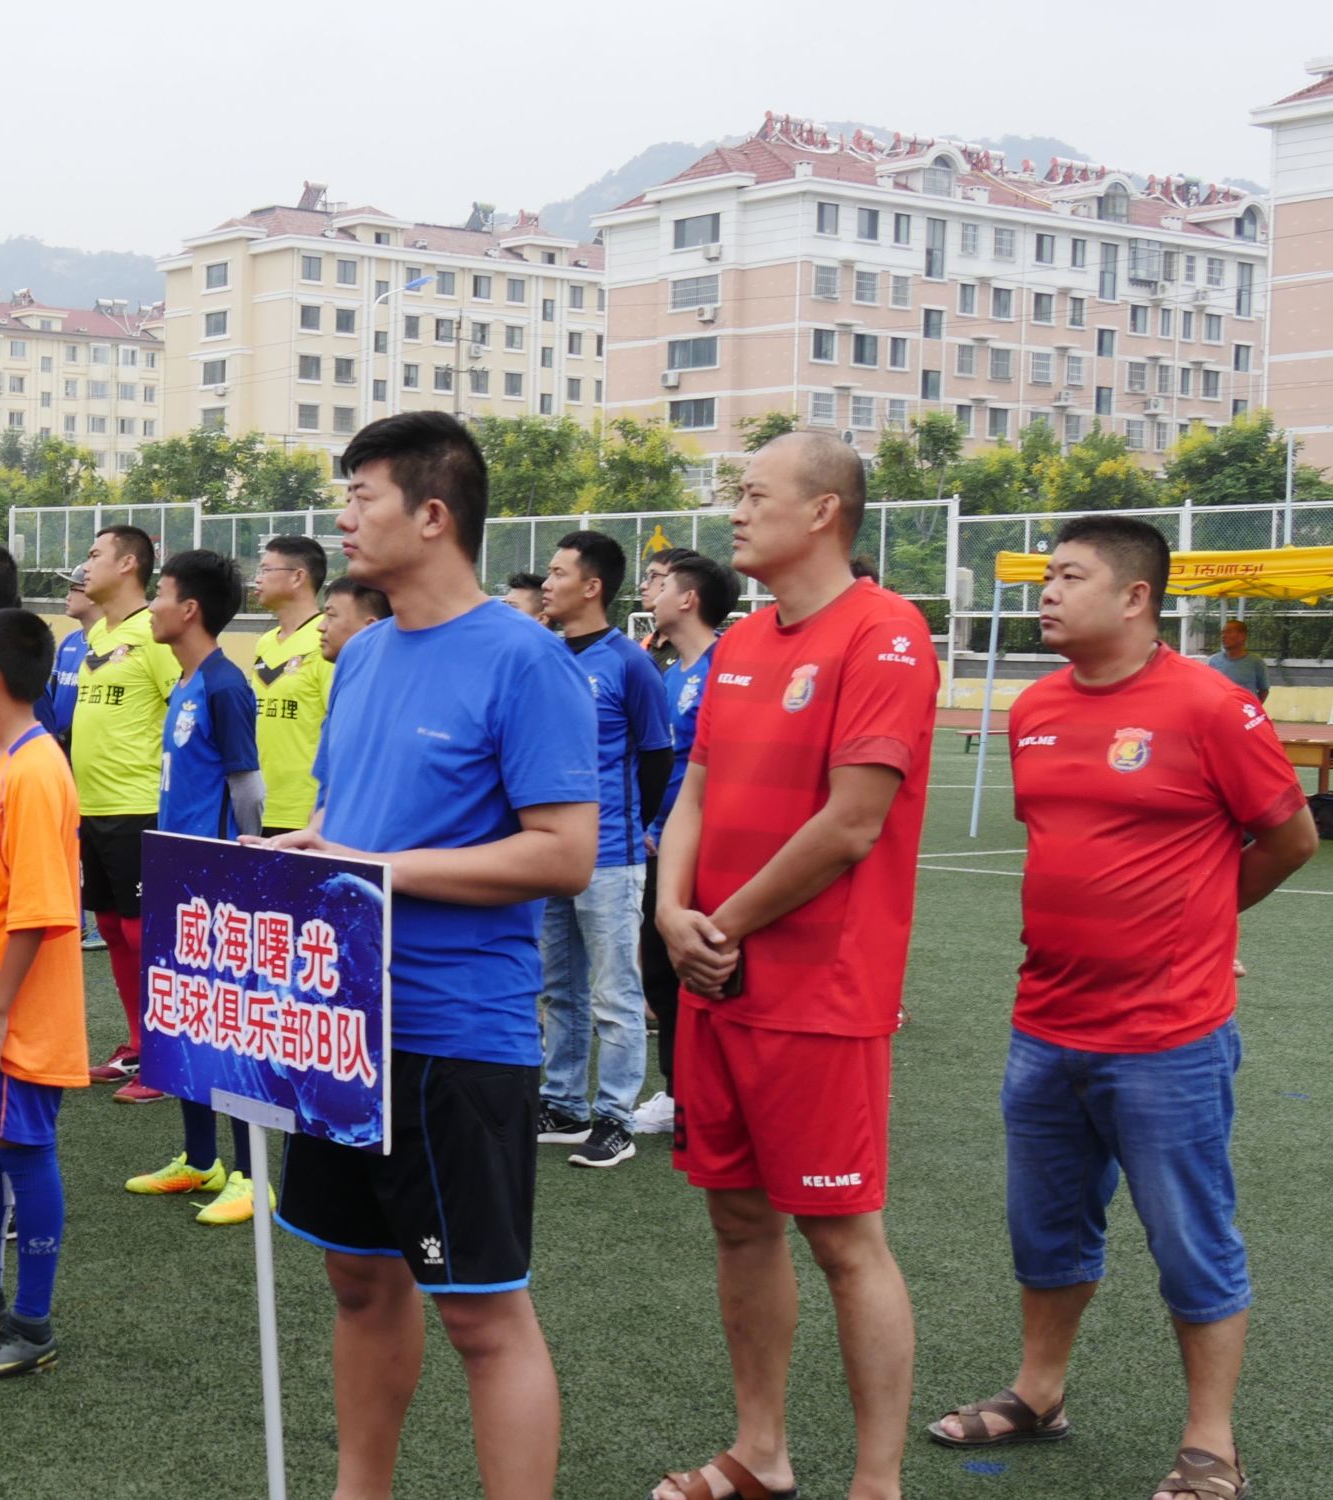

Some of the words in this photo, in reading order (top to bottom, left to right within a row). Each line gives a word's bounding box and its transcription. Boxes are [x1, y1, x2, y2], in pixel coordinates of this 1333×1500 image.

[878, 653, 916, 666] KELME
[1017, 735, 1058, 748] KELME
[175, 897, 339, 997] 威海曙光
[145, 966, 378, 1088] 足球俱乐部B队
[802, 1173, 862, 1188] KELME
